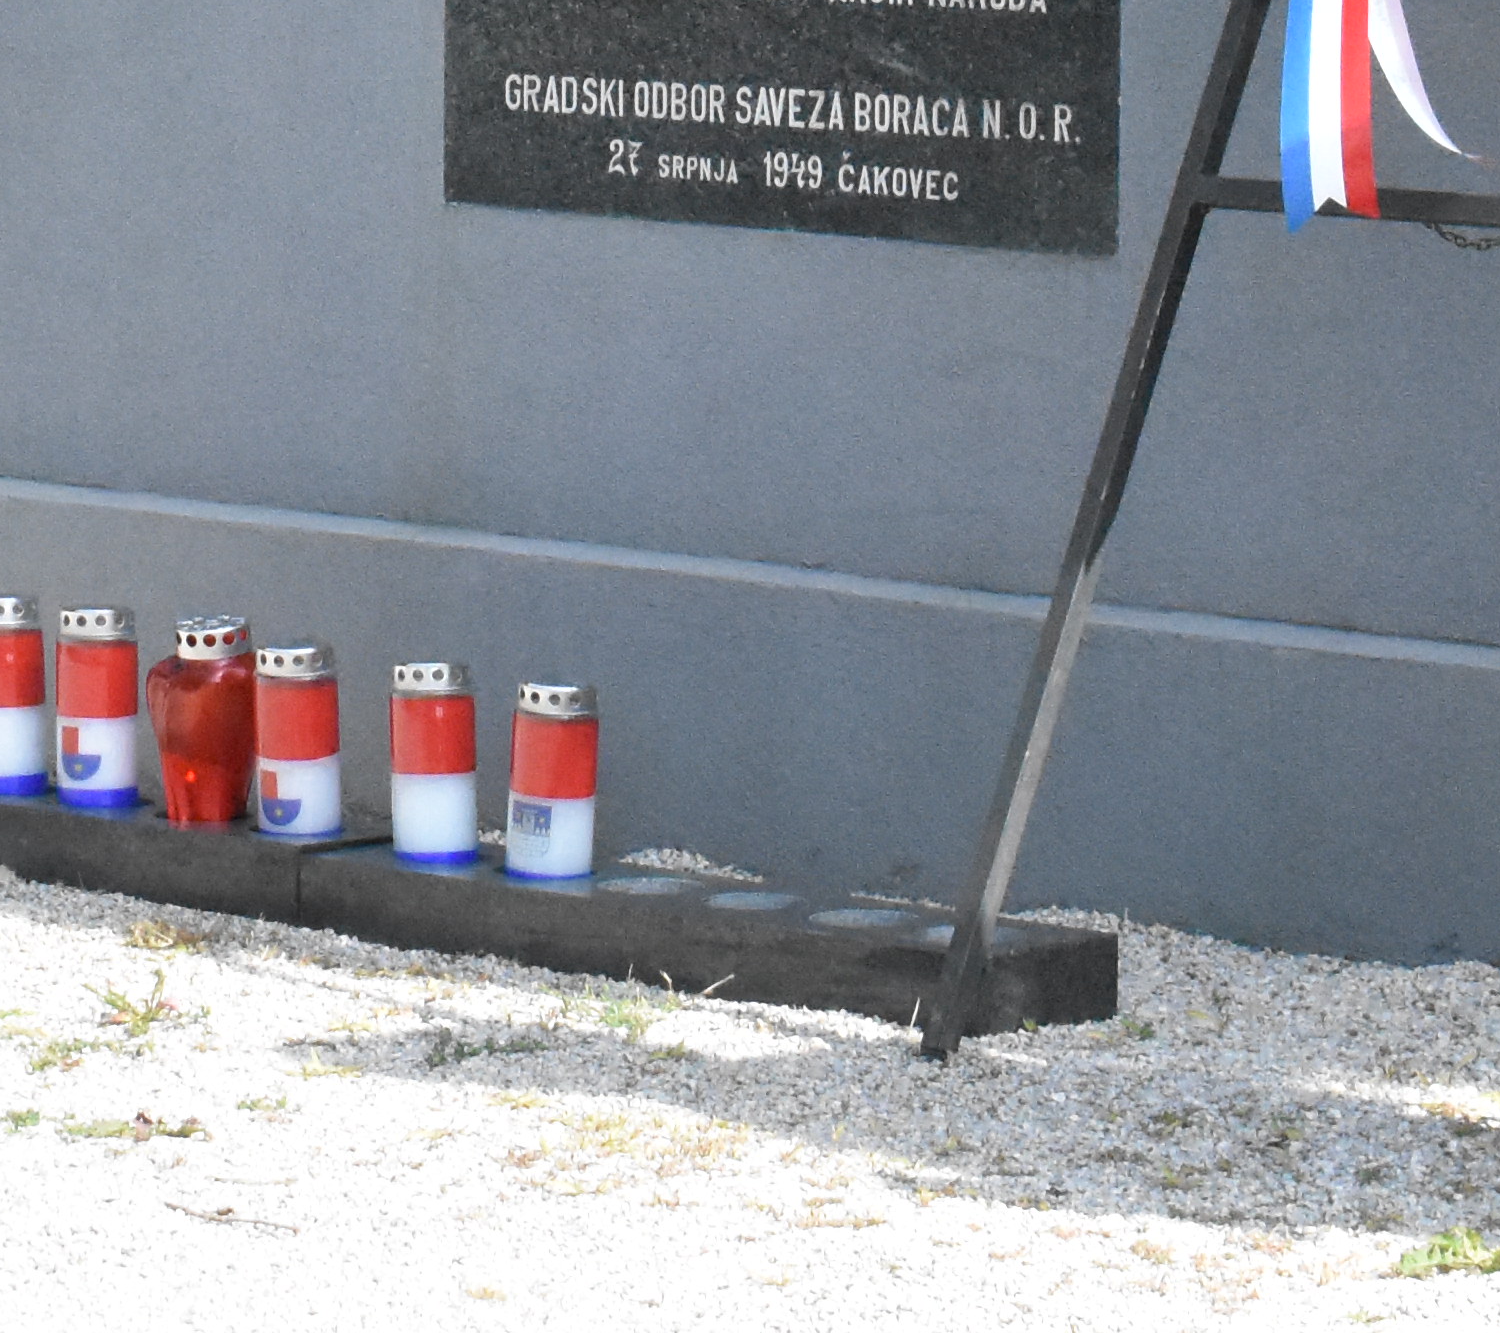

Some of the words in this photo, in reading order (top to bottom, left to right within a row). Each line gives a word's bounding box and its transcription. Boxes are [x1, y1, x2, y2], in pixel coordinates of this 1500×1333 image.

[504, 72, 625, 118] GRADSKI
[633, 79, 726, 124] ODBOR
[734, 85, 845, 131] SAVEZA
[853, 91, 970, 138] BORACA
[607, 138, 643, 177] 27
[657, 153, 739, 185] SRPNJA
[762, 150, 823, 190] 1949
[837, 150, 959, 201] ČAKOVEC
